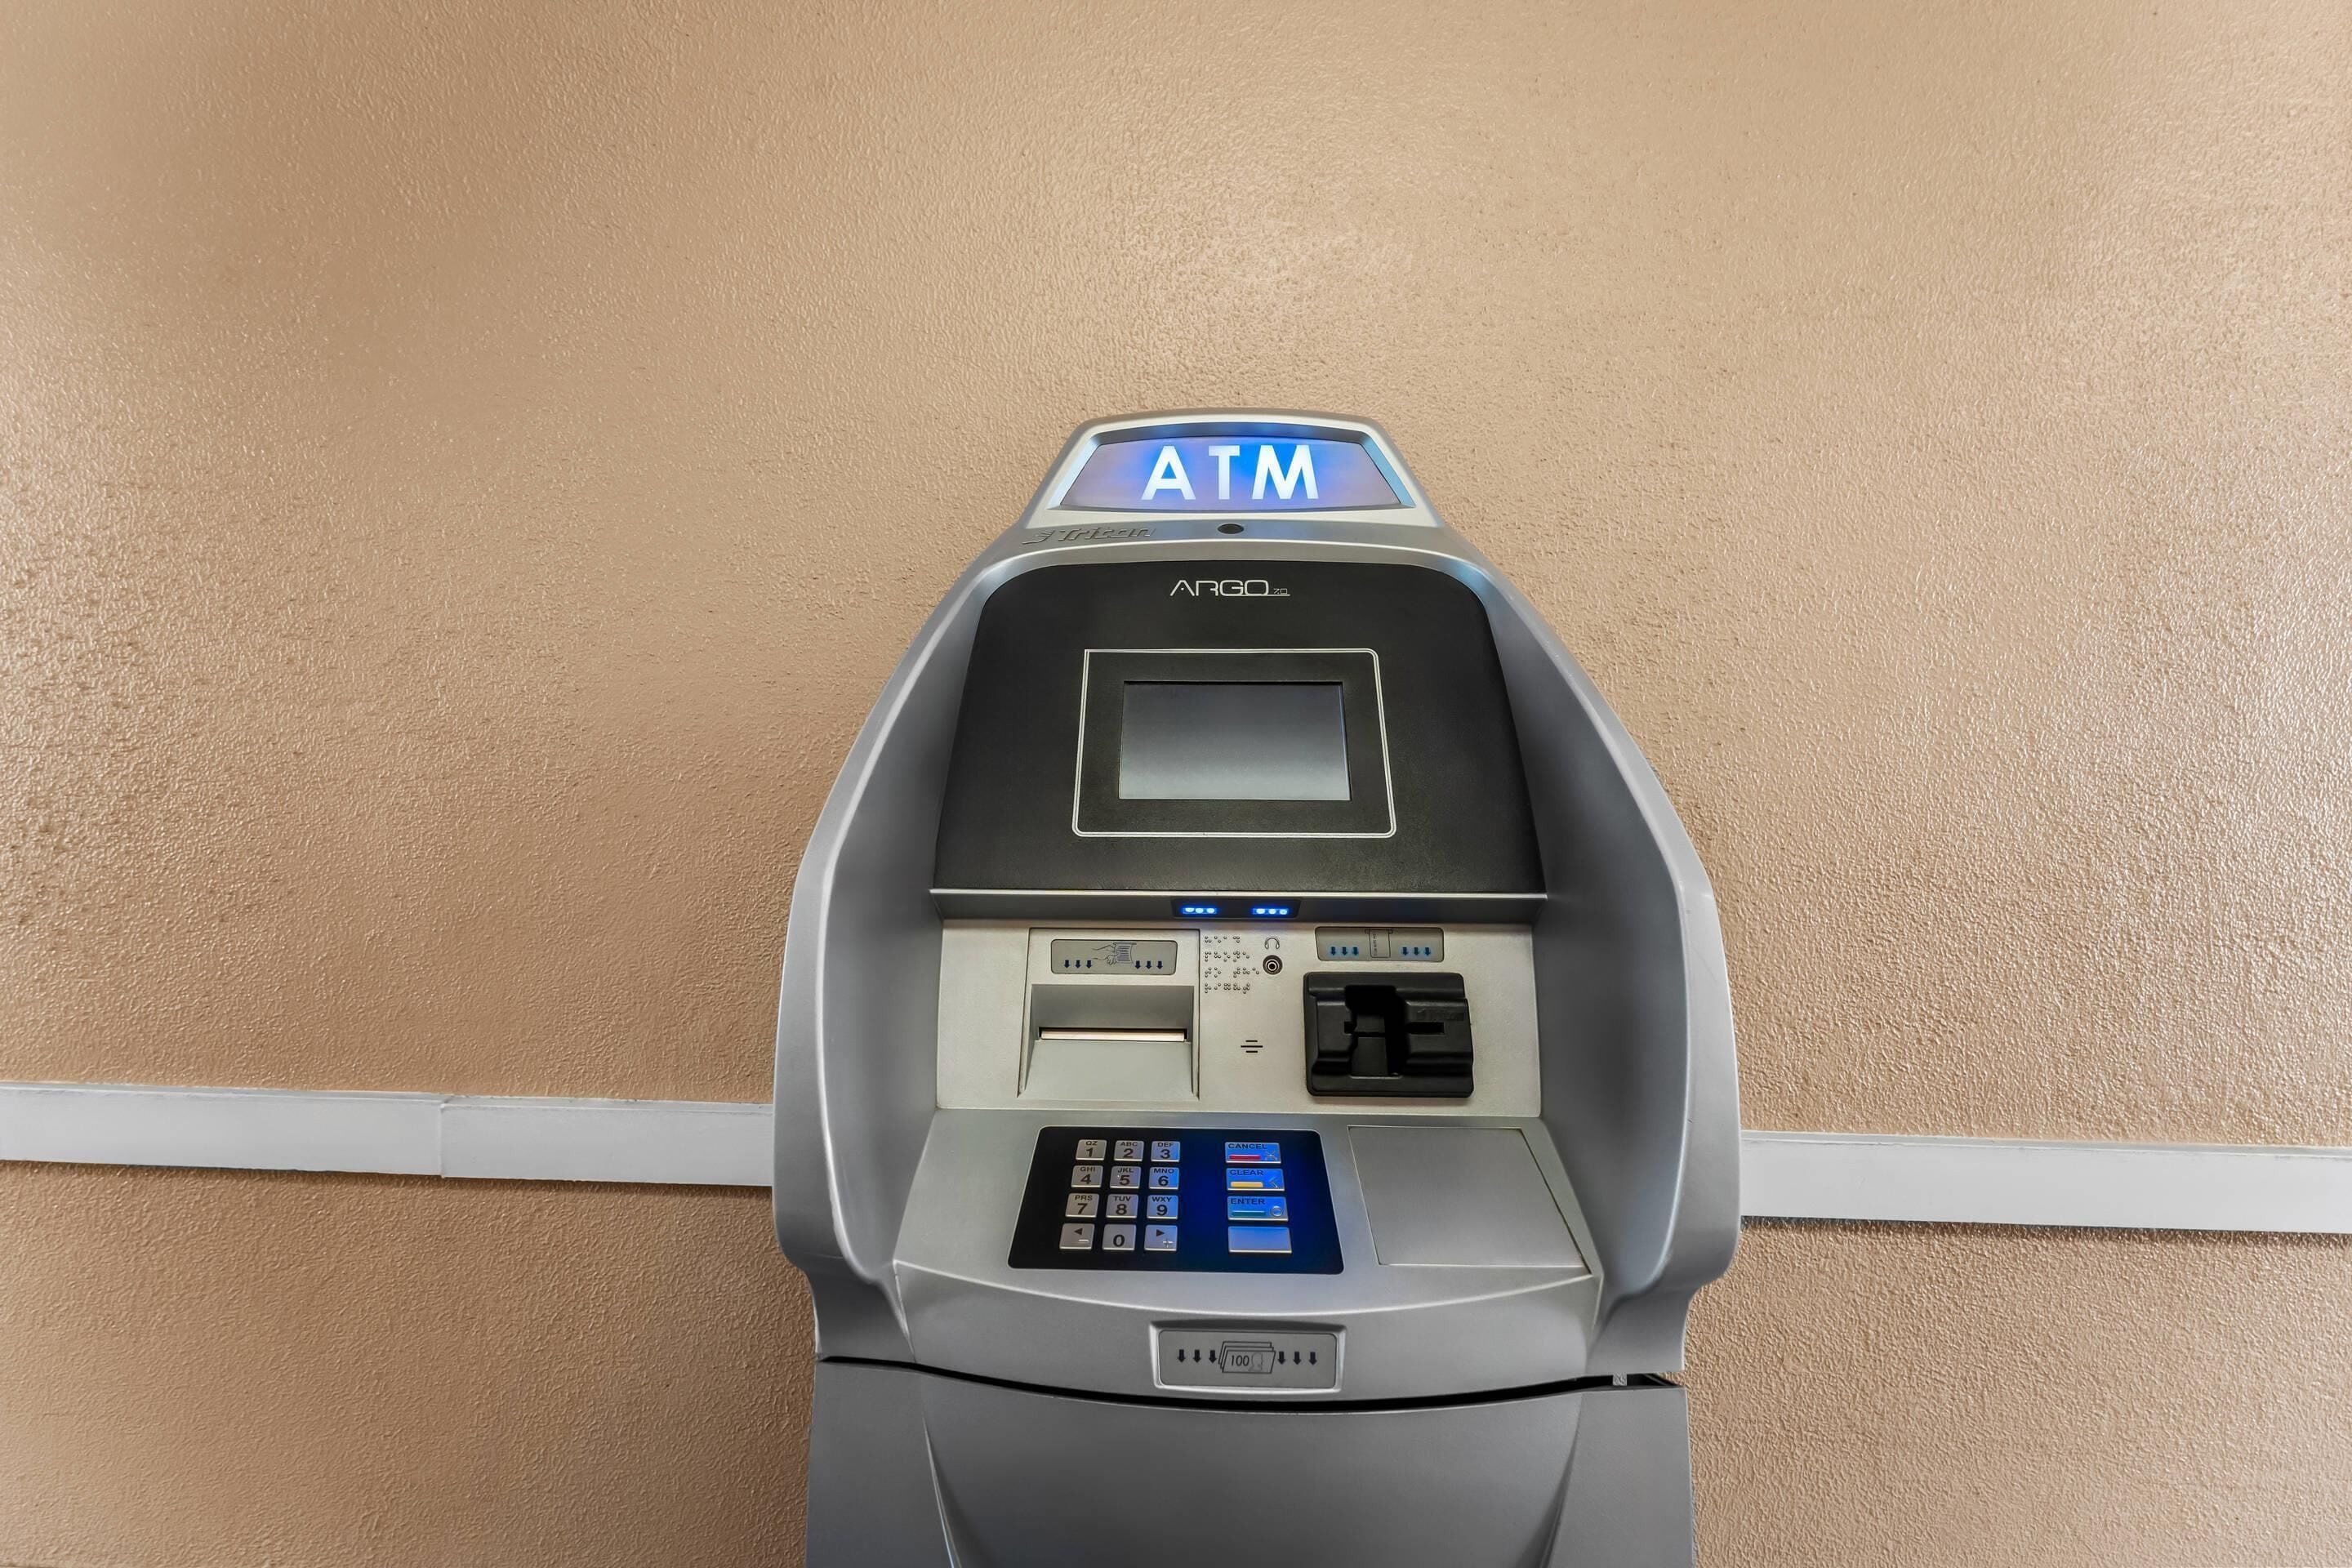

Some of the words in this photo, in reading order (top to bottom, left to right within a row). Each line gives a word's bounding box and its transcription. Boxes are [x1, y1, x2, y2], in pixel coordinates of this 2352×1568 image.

[1141, 444, 1319, 500] ATM
[1169, 580, 1269, 596] ARGO
[1086, 1147, 1094, 1157] 1
[1123, 1148, 1134, 1158] 2
[1160, 1149, 1171, 1159] 3
[1080, 1174, 1092, 1184] 4
[1119, 1174, 1130, 1186] 5
[1158, 1175, 1169, 1187] 6
[1077, 1203, 1088, 1214] 7
[1116, 1204, 1127, 1215] 8
[1156, 1204, 1168, 1216] 9
[1113, 1234, 1125, 1247] 0
[1231, 1355, 1250, 1367] 100
